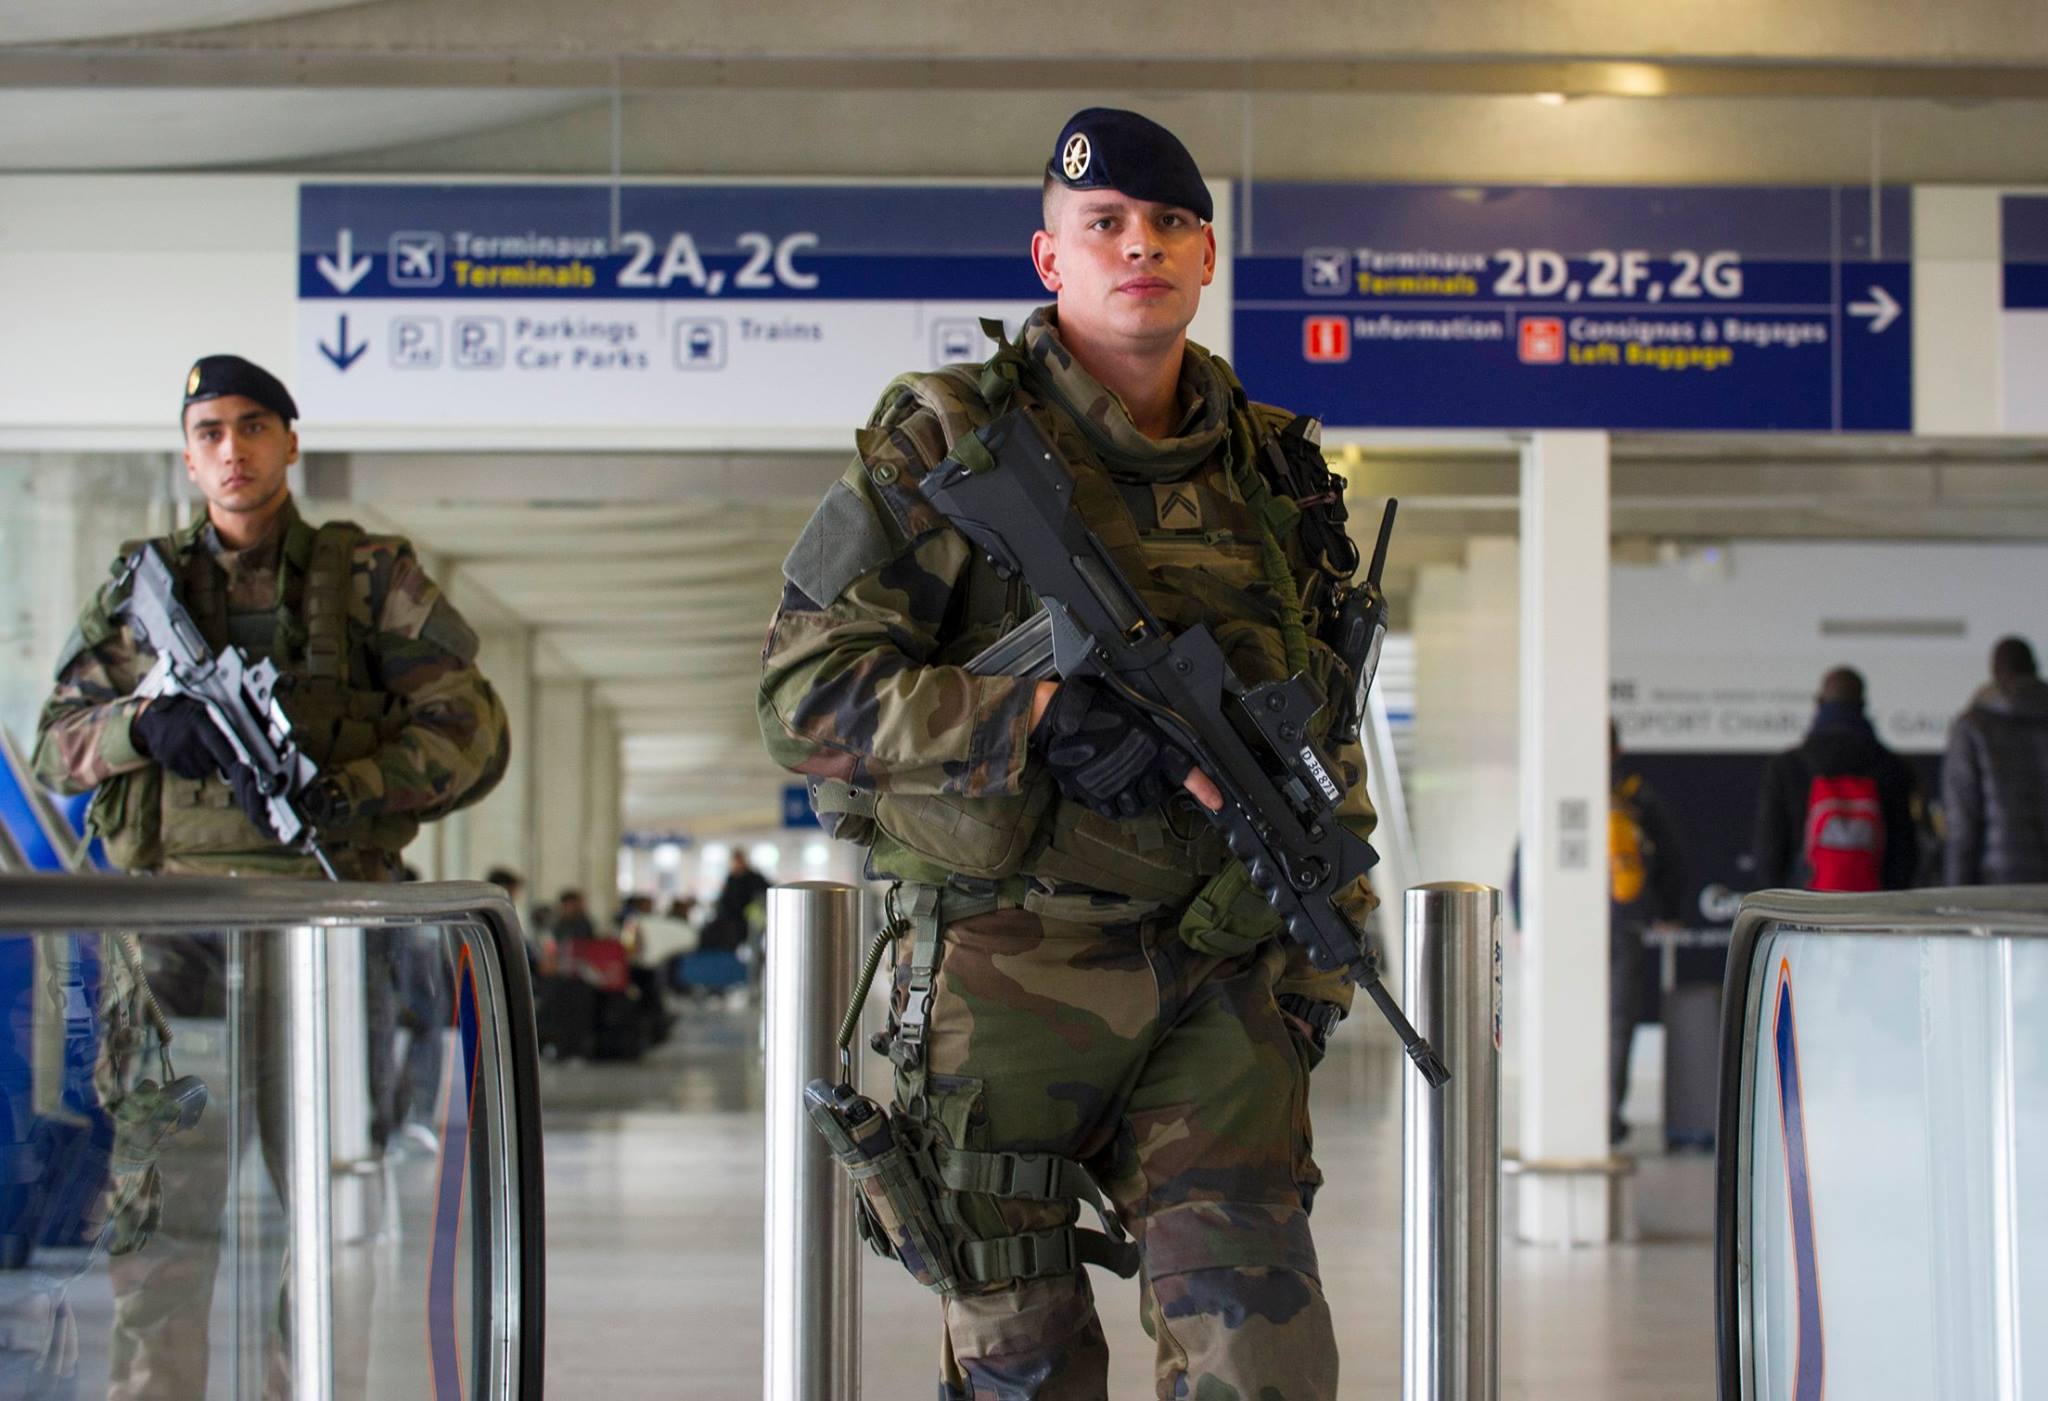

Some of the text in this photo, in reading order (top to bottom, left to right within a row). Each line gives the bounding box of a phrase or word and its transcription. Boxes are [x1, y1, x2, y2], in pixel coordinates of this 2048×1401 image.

[452, 231, 606, 257] Terminaux
[1356, 246, 1487, 272] Terminaux
[453, 260, 594, 287] Terminals
[1356, 270, 1478, 295] Terminals
[515, 317, 637, 344] Parkings
[737, 317, 823, 341] Trains
[1354, 315, 1503, 339] Information
[1568, 317, 1694, 345] Consignes
[1723, 318, 1827, 347] Bagages
[515, 346, 560, 369] Car
[573, 346, 648, 369] Parks
[1568, 342, 1734, 370] Left Baggage
